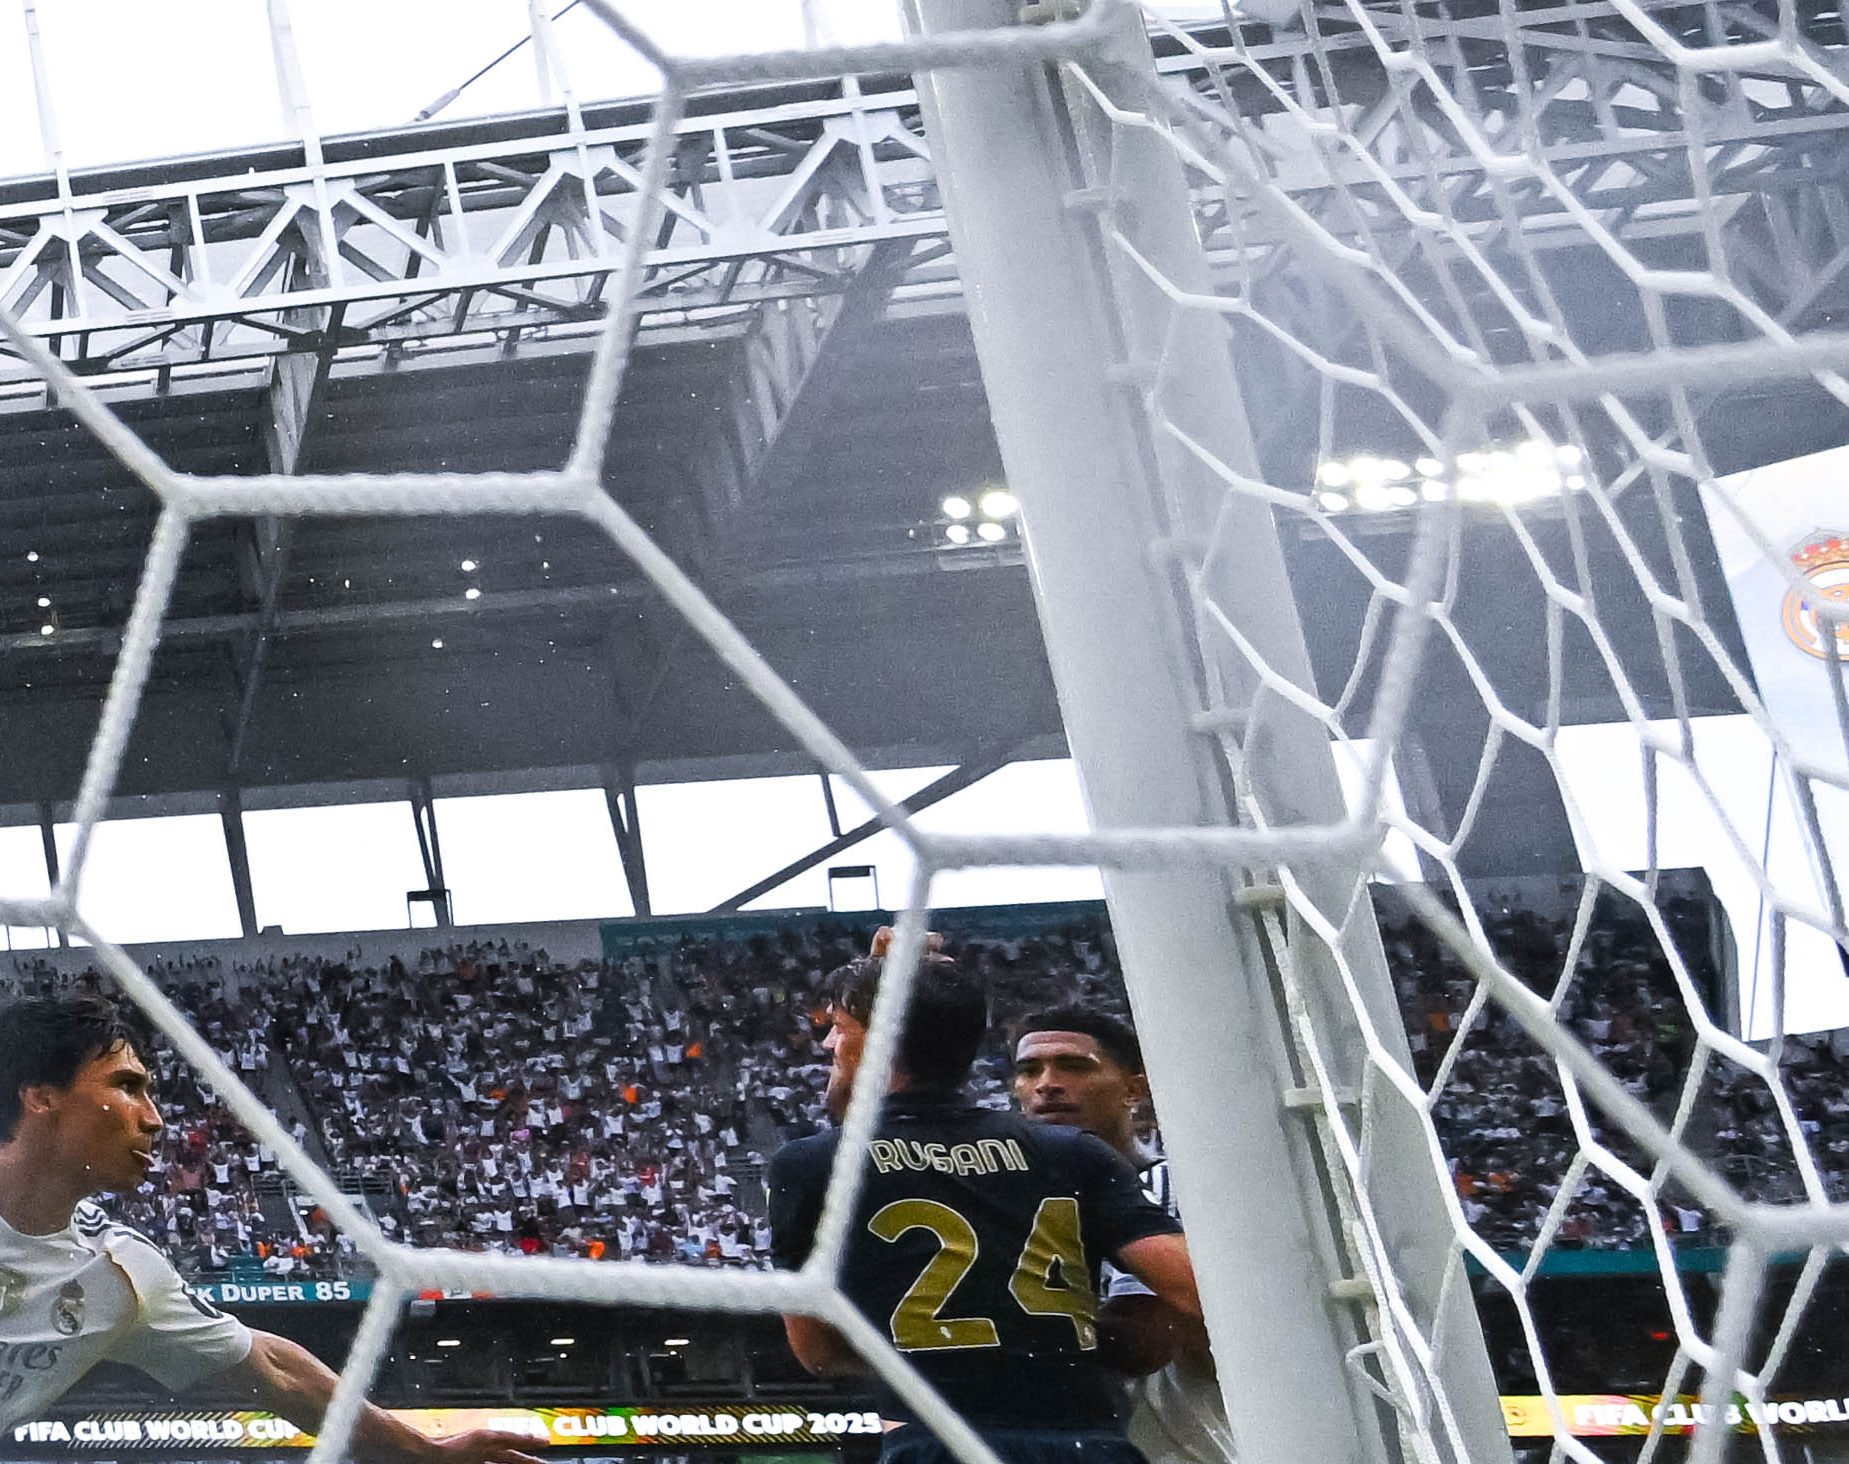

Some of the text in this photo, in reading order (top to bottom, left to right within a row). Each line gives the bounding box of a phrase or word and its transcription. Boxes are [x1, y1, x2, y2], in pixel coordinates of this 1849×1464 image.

[870, 1136, 1029, 1177] RUGANI
[867, 1196, 1098, 1353] 24
[314, 1279, 351, 1301] 85
[553, 1415, 628, 1438] CLUB
[629, 1414, 739, 1437] WORLD
[741, 1413, 806, 1436] CUP
[1573, 1403, 1650, 1427] FIFA
[14, 1417, 302, 1442] FIFA CLUB WORLD CUP
